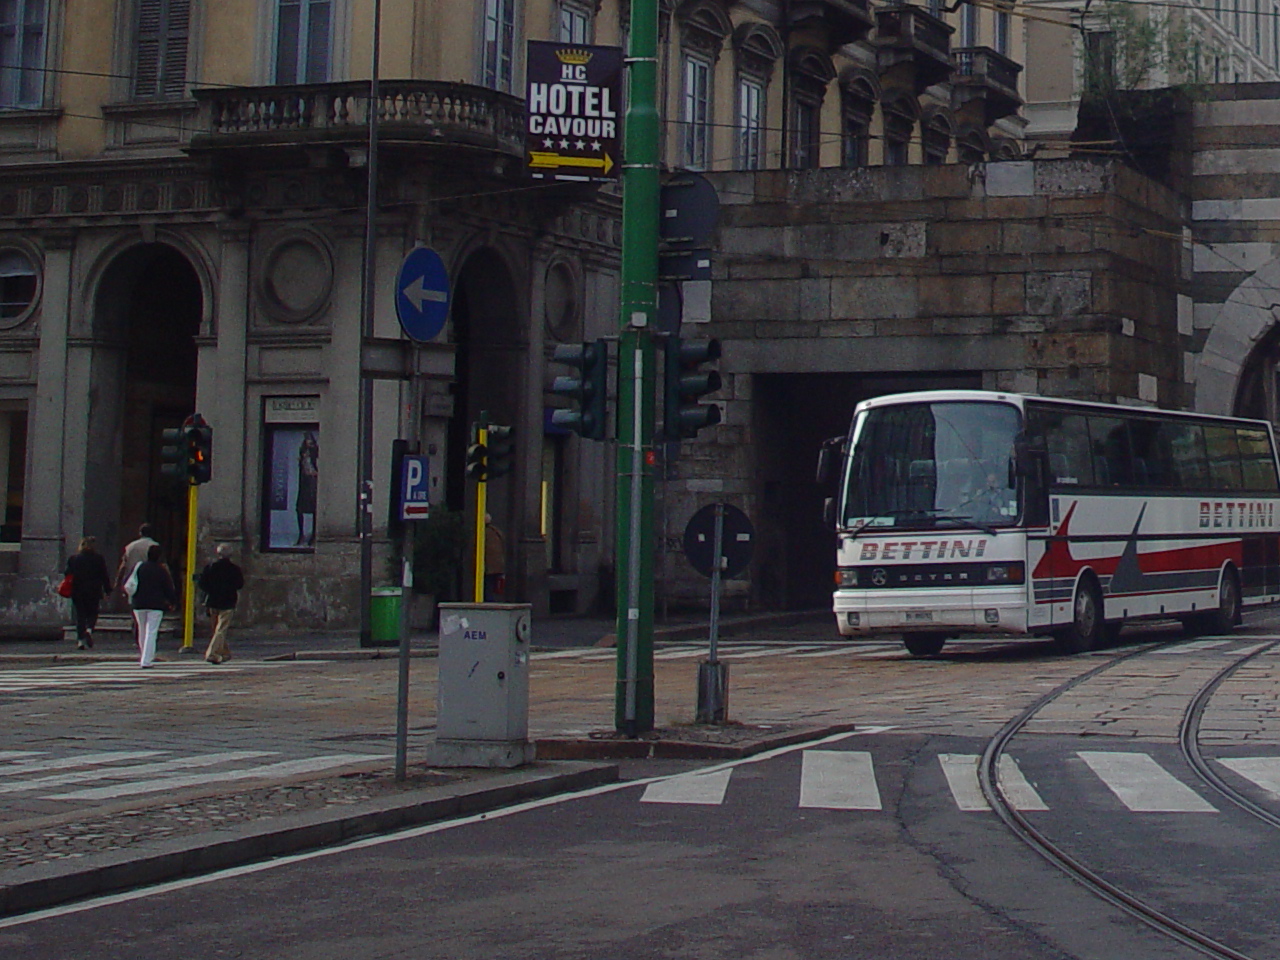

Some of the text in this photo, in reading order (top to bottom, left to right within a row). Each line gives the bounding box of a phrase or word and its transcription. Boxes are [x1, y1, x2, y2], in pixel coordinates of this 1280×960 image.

[562, 64, 586, 79] HC
[530, 82, 616, 118] HOTEL
[529, 115, 616, 138] CAVOUR
[406, 459, 422, 500] P
[1199, 501, 1274, 528] BETTINI
[859, 539, 988, 561] BETTINI
[464, 630, 487, 640] AEM
